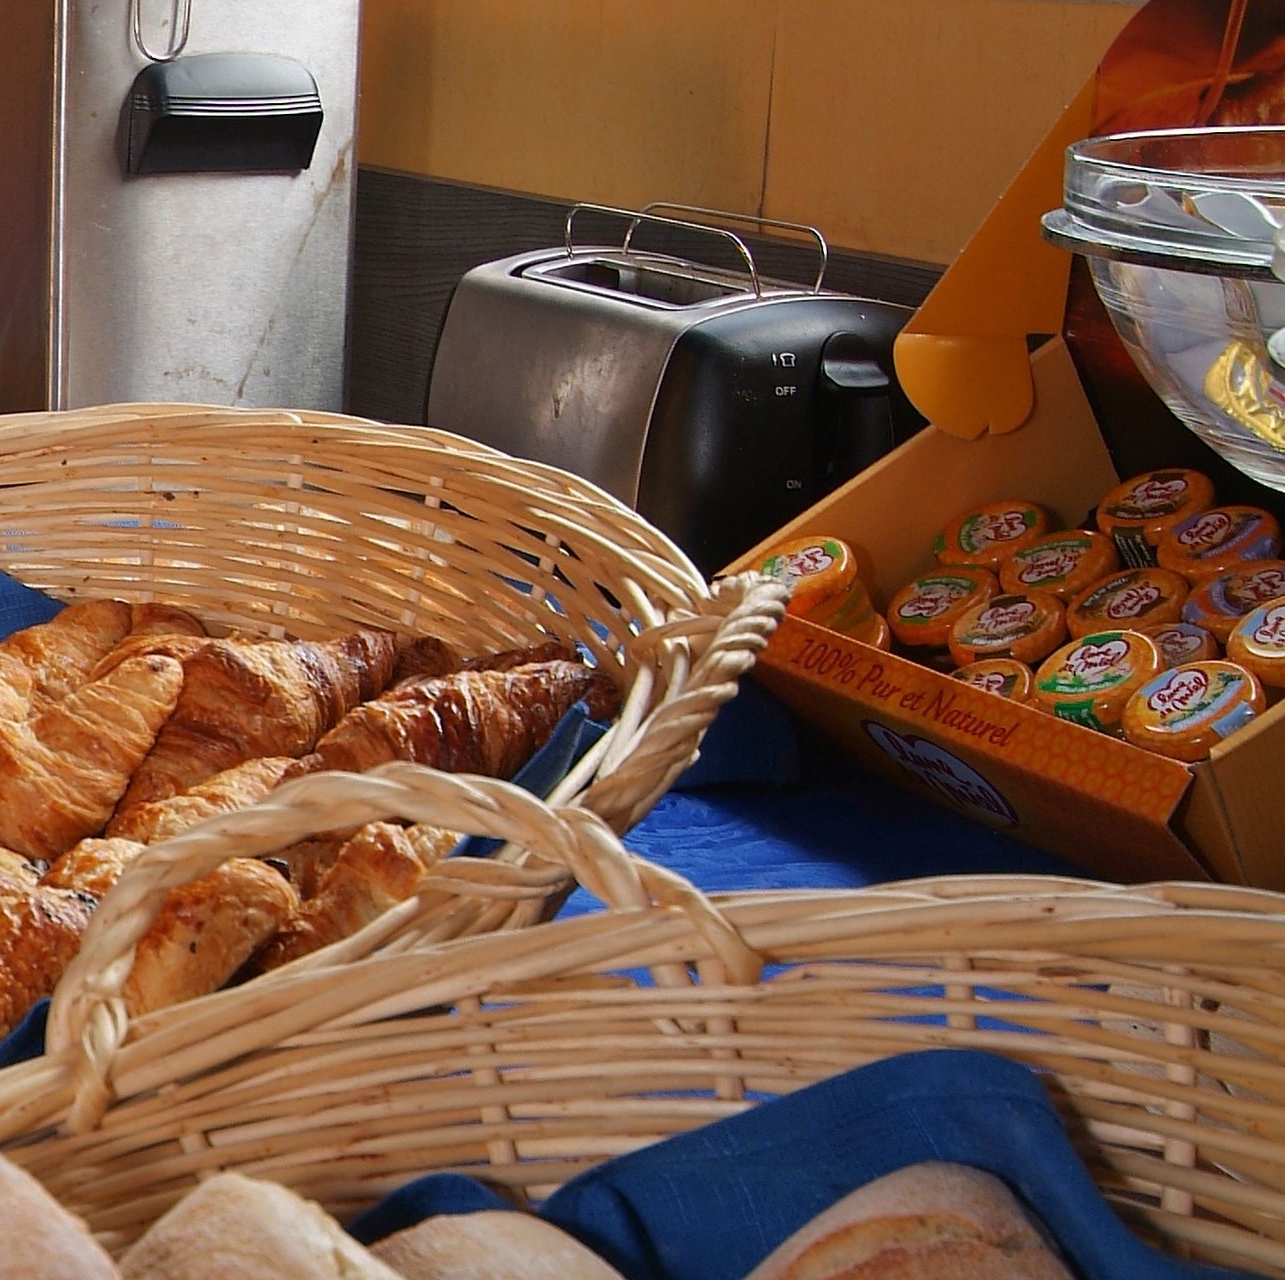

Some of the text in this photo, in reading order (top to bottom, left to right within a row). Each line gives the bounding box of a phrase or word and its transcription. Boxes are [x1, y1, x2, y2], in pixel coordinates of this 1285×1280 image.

[775, 386, 797, 396] OFF
[786, 480, 803, 490] ON
[791, 638, 863, 684] 100%
[857, 664, 901, 699] Pur
[899, 691, 925, 711] et
[921, 689, 1020, 747] Naturel
